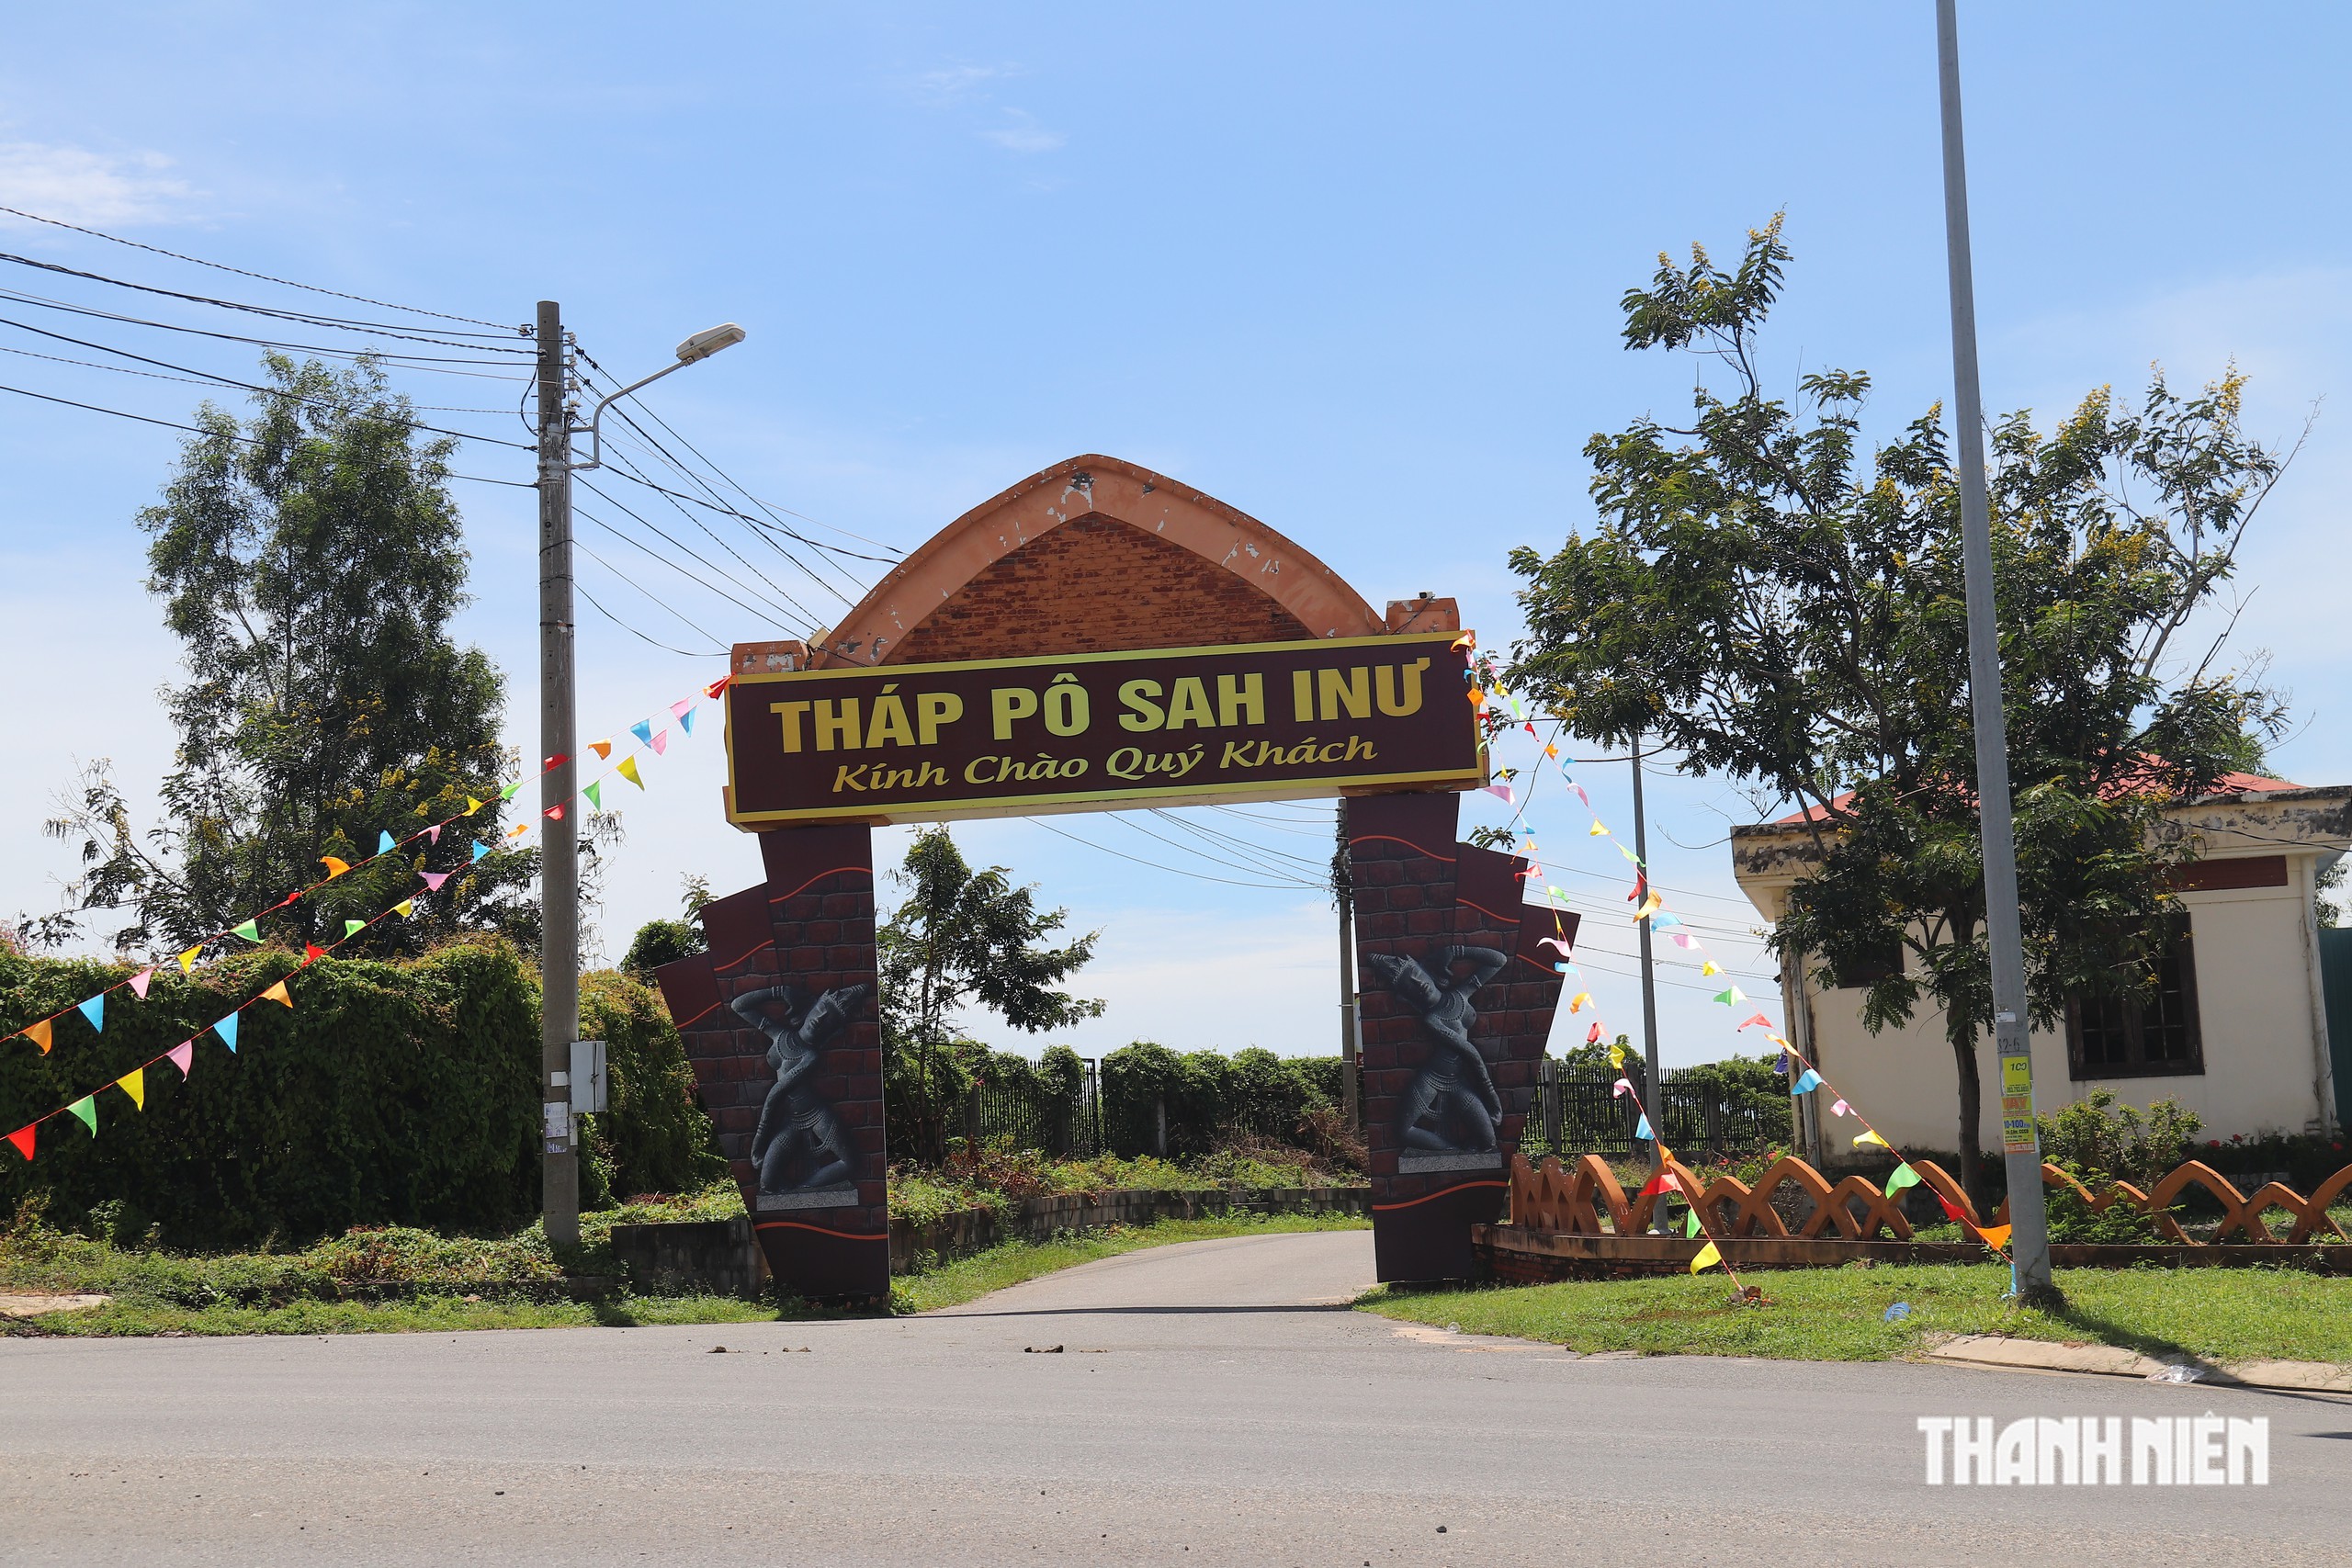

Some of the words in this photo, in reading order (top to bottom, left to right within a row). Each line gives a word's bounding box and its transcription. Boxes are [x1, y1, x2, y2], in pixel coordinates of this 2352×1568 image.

[769, 683, 965, 753] THÁP
[992, 672, 1090, 739] PÔ
[1119, 673, 1265, 732] SAH
[1293, 657, 1430, 722] INƯ
[832, 761, 946, 793] Kính
[964, 750, 1088, 784] Chào
[1107, 742, 1204, 779] Quý
[1220, 736, 1378, 769] Khách
